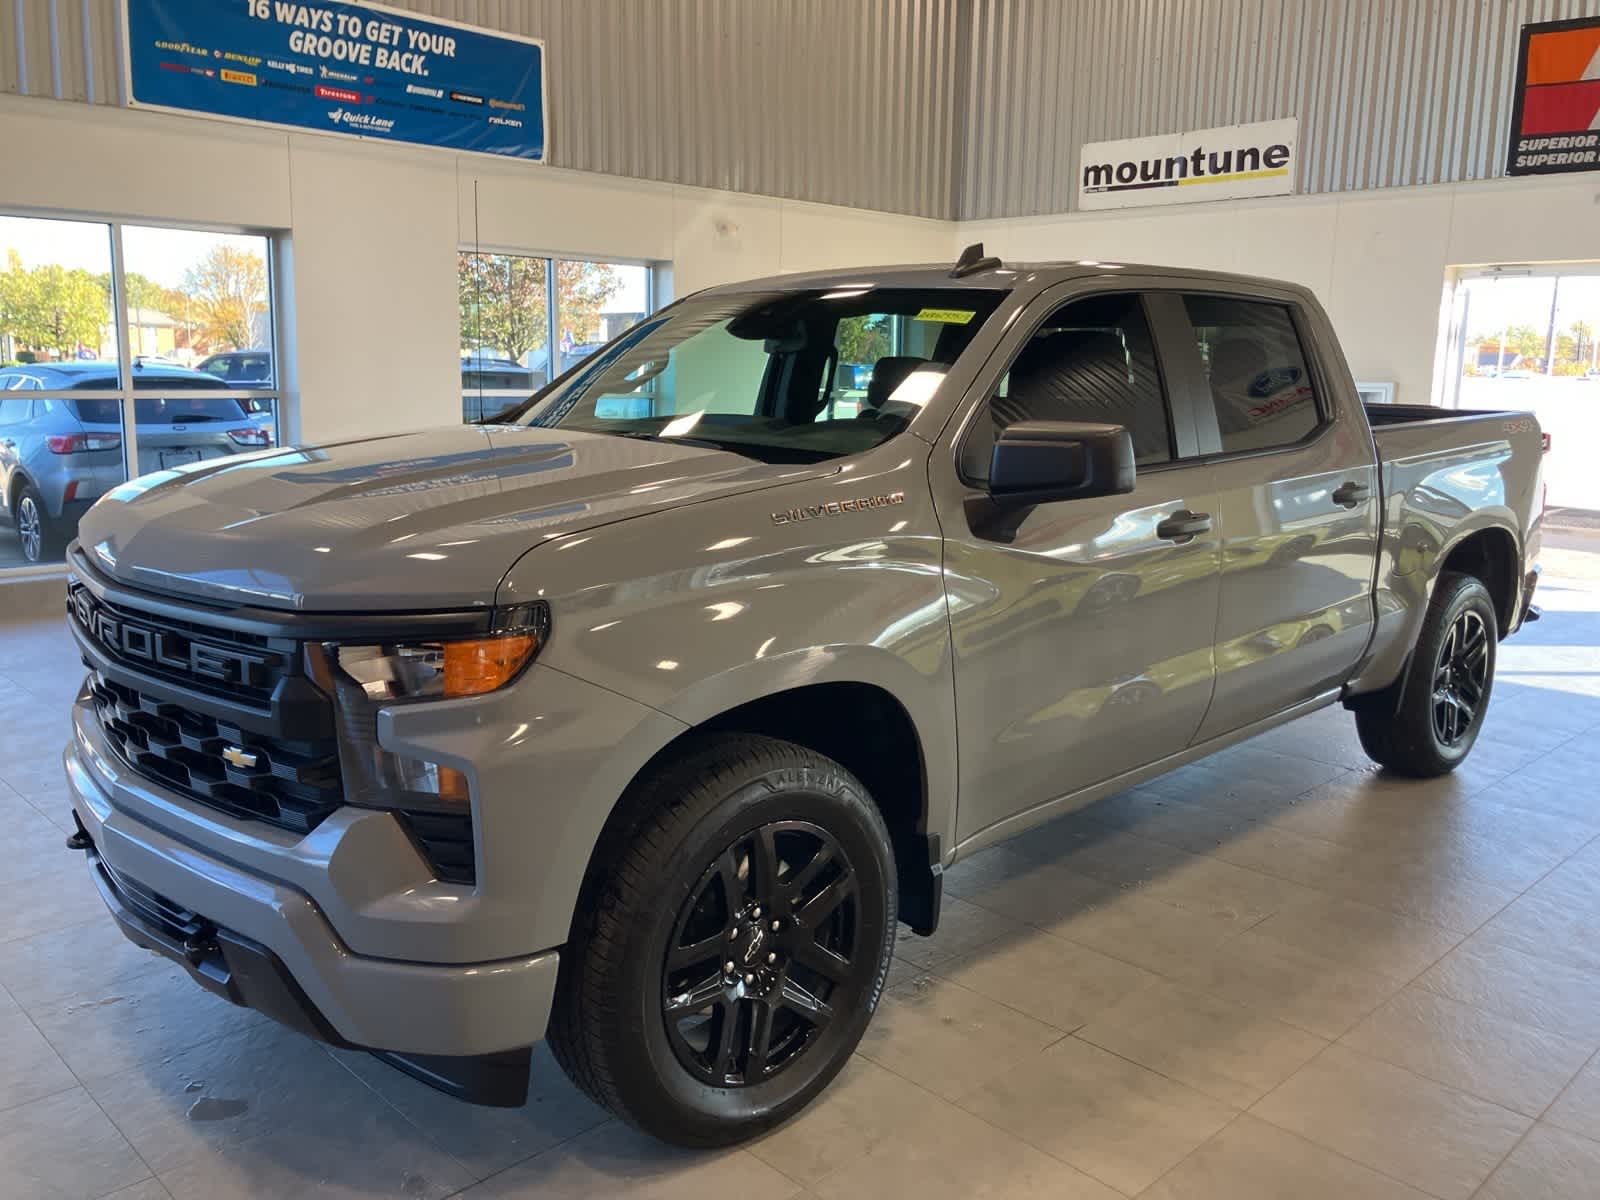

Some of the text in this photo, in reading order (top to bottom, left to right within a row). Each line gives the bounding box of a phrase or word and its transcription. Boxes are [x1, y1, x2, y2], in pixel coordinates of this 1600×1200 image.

[248, 0, 456, 57] 16 WAYS TO GET YOUR
[289, 30, 429, 76] GROOVE BACK.
[342, 111, 371, 125] Quick
[371, 115, 395, 128] Lane
[1516, 151, 1597, 167] SUPERIOR
[1518, 135, 1599, 152] SUPERIOR
[1083, 144, 1290, 187] mountune
[771, 491, 904, 525] SILVERADO
